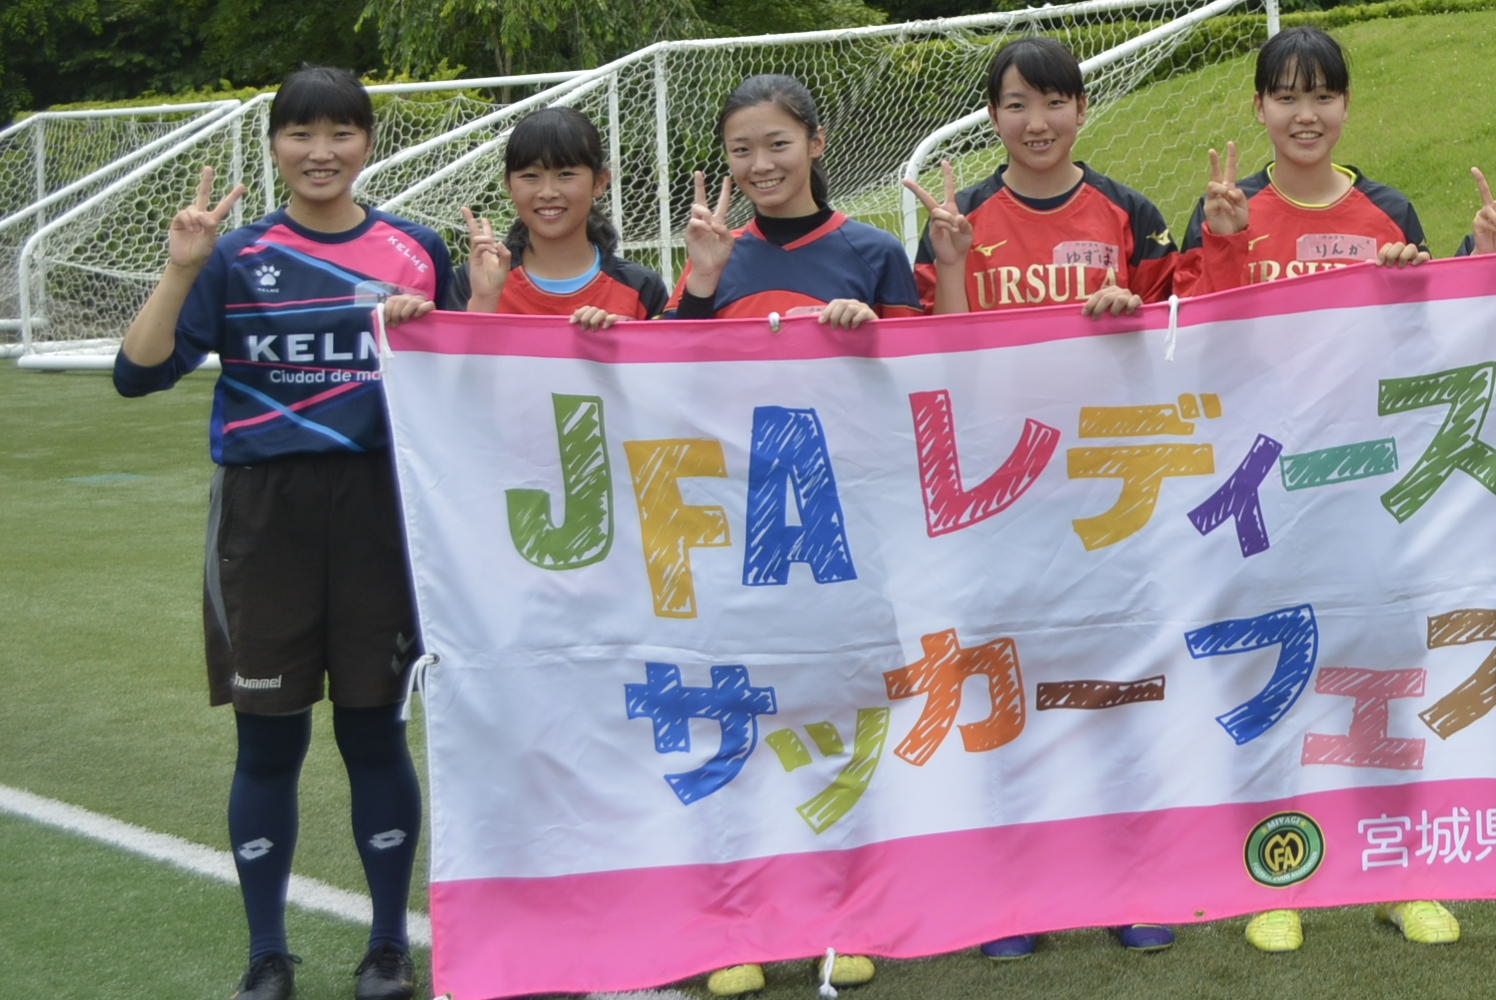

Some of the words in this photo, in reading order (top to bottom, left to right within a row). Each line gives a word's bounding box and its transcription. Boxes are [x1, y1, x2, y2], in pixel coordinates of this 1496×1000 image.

[387, 235, 430, 273] KELME
[270, 369, 326, 383] Ciudad
[331, 368, 352, 382] de
[505, 392, 857, 619] JFA
[234, 671, 283, 689] hummel
